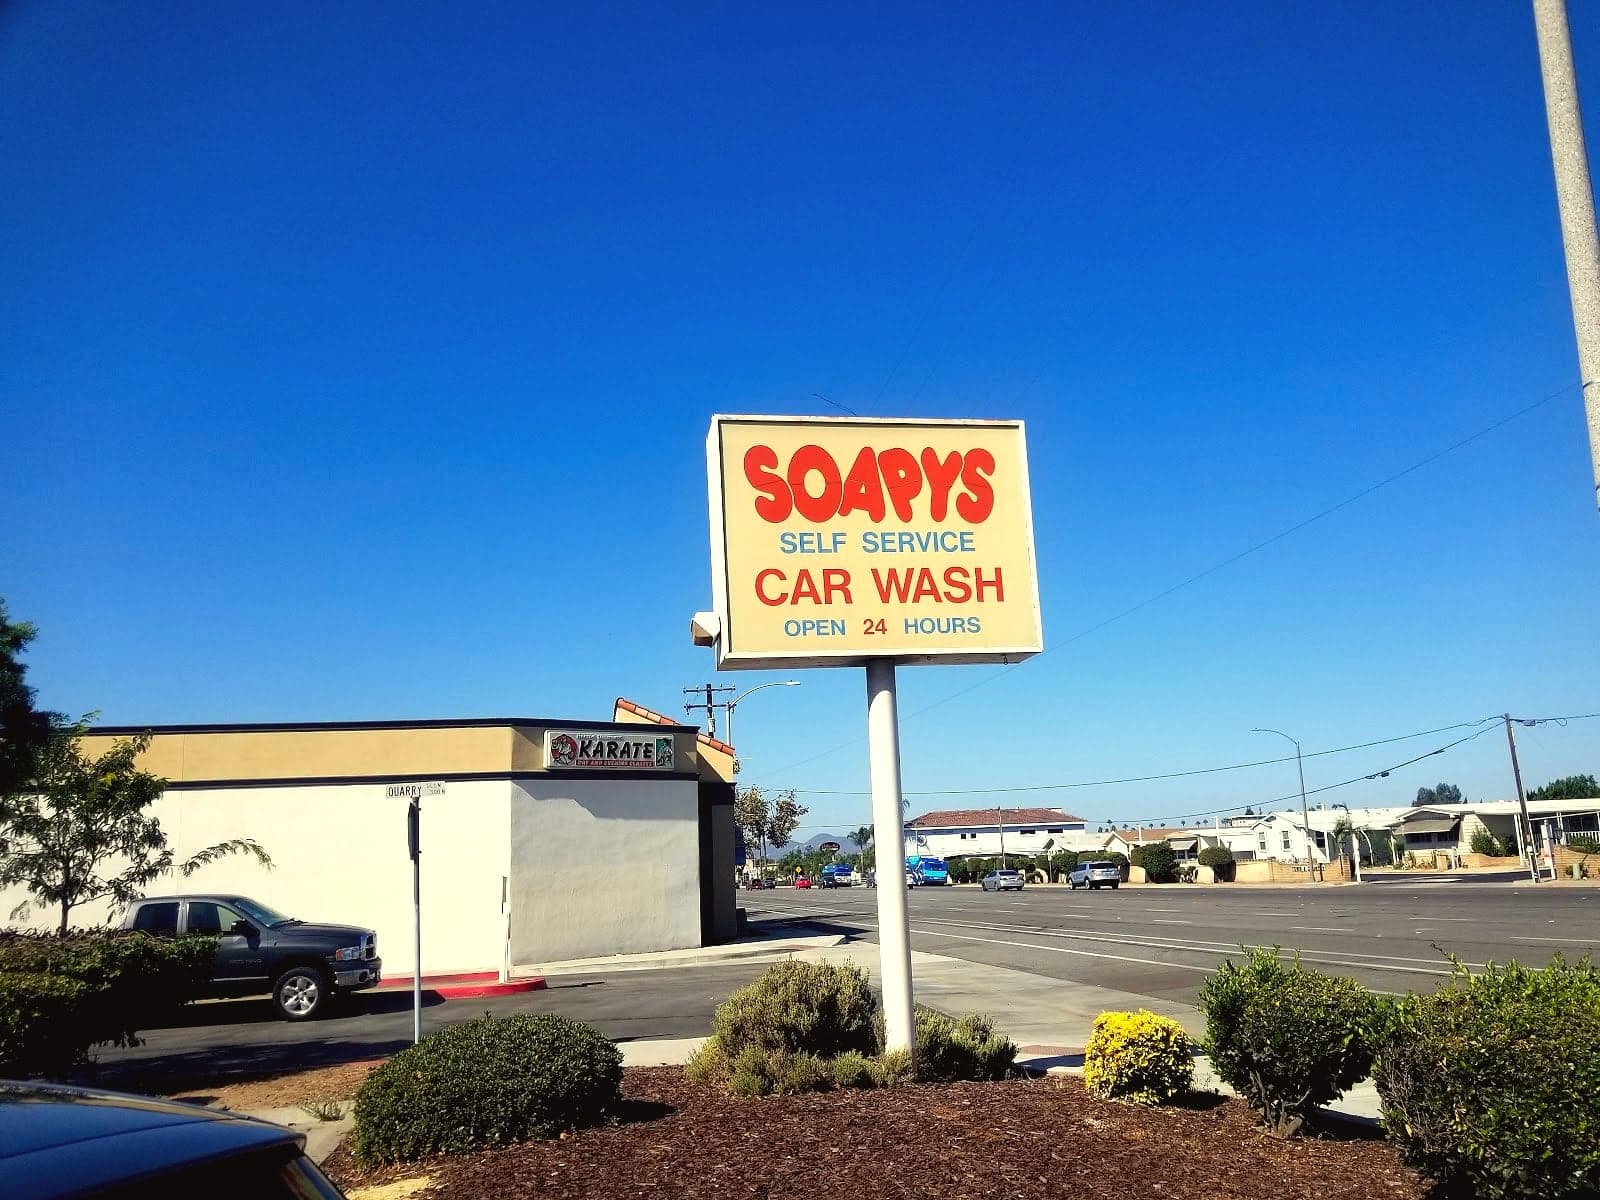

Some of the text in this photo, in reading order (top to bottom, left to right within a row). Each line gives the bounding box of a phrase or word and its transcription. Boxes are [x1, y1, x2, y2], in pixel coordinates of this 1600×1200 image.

[743, 444, 995, 524] SOAPYS
[780, 531, 975, 554] SELF SERVICE
[755, 567, 1005, 606] CAR WASH
[784, 617, 981, 637] OPEN 24 HOURS
[579, 740, 654, 759] KARATE
[388, 785, 422, 797] QUARRY
